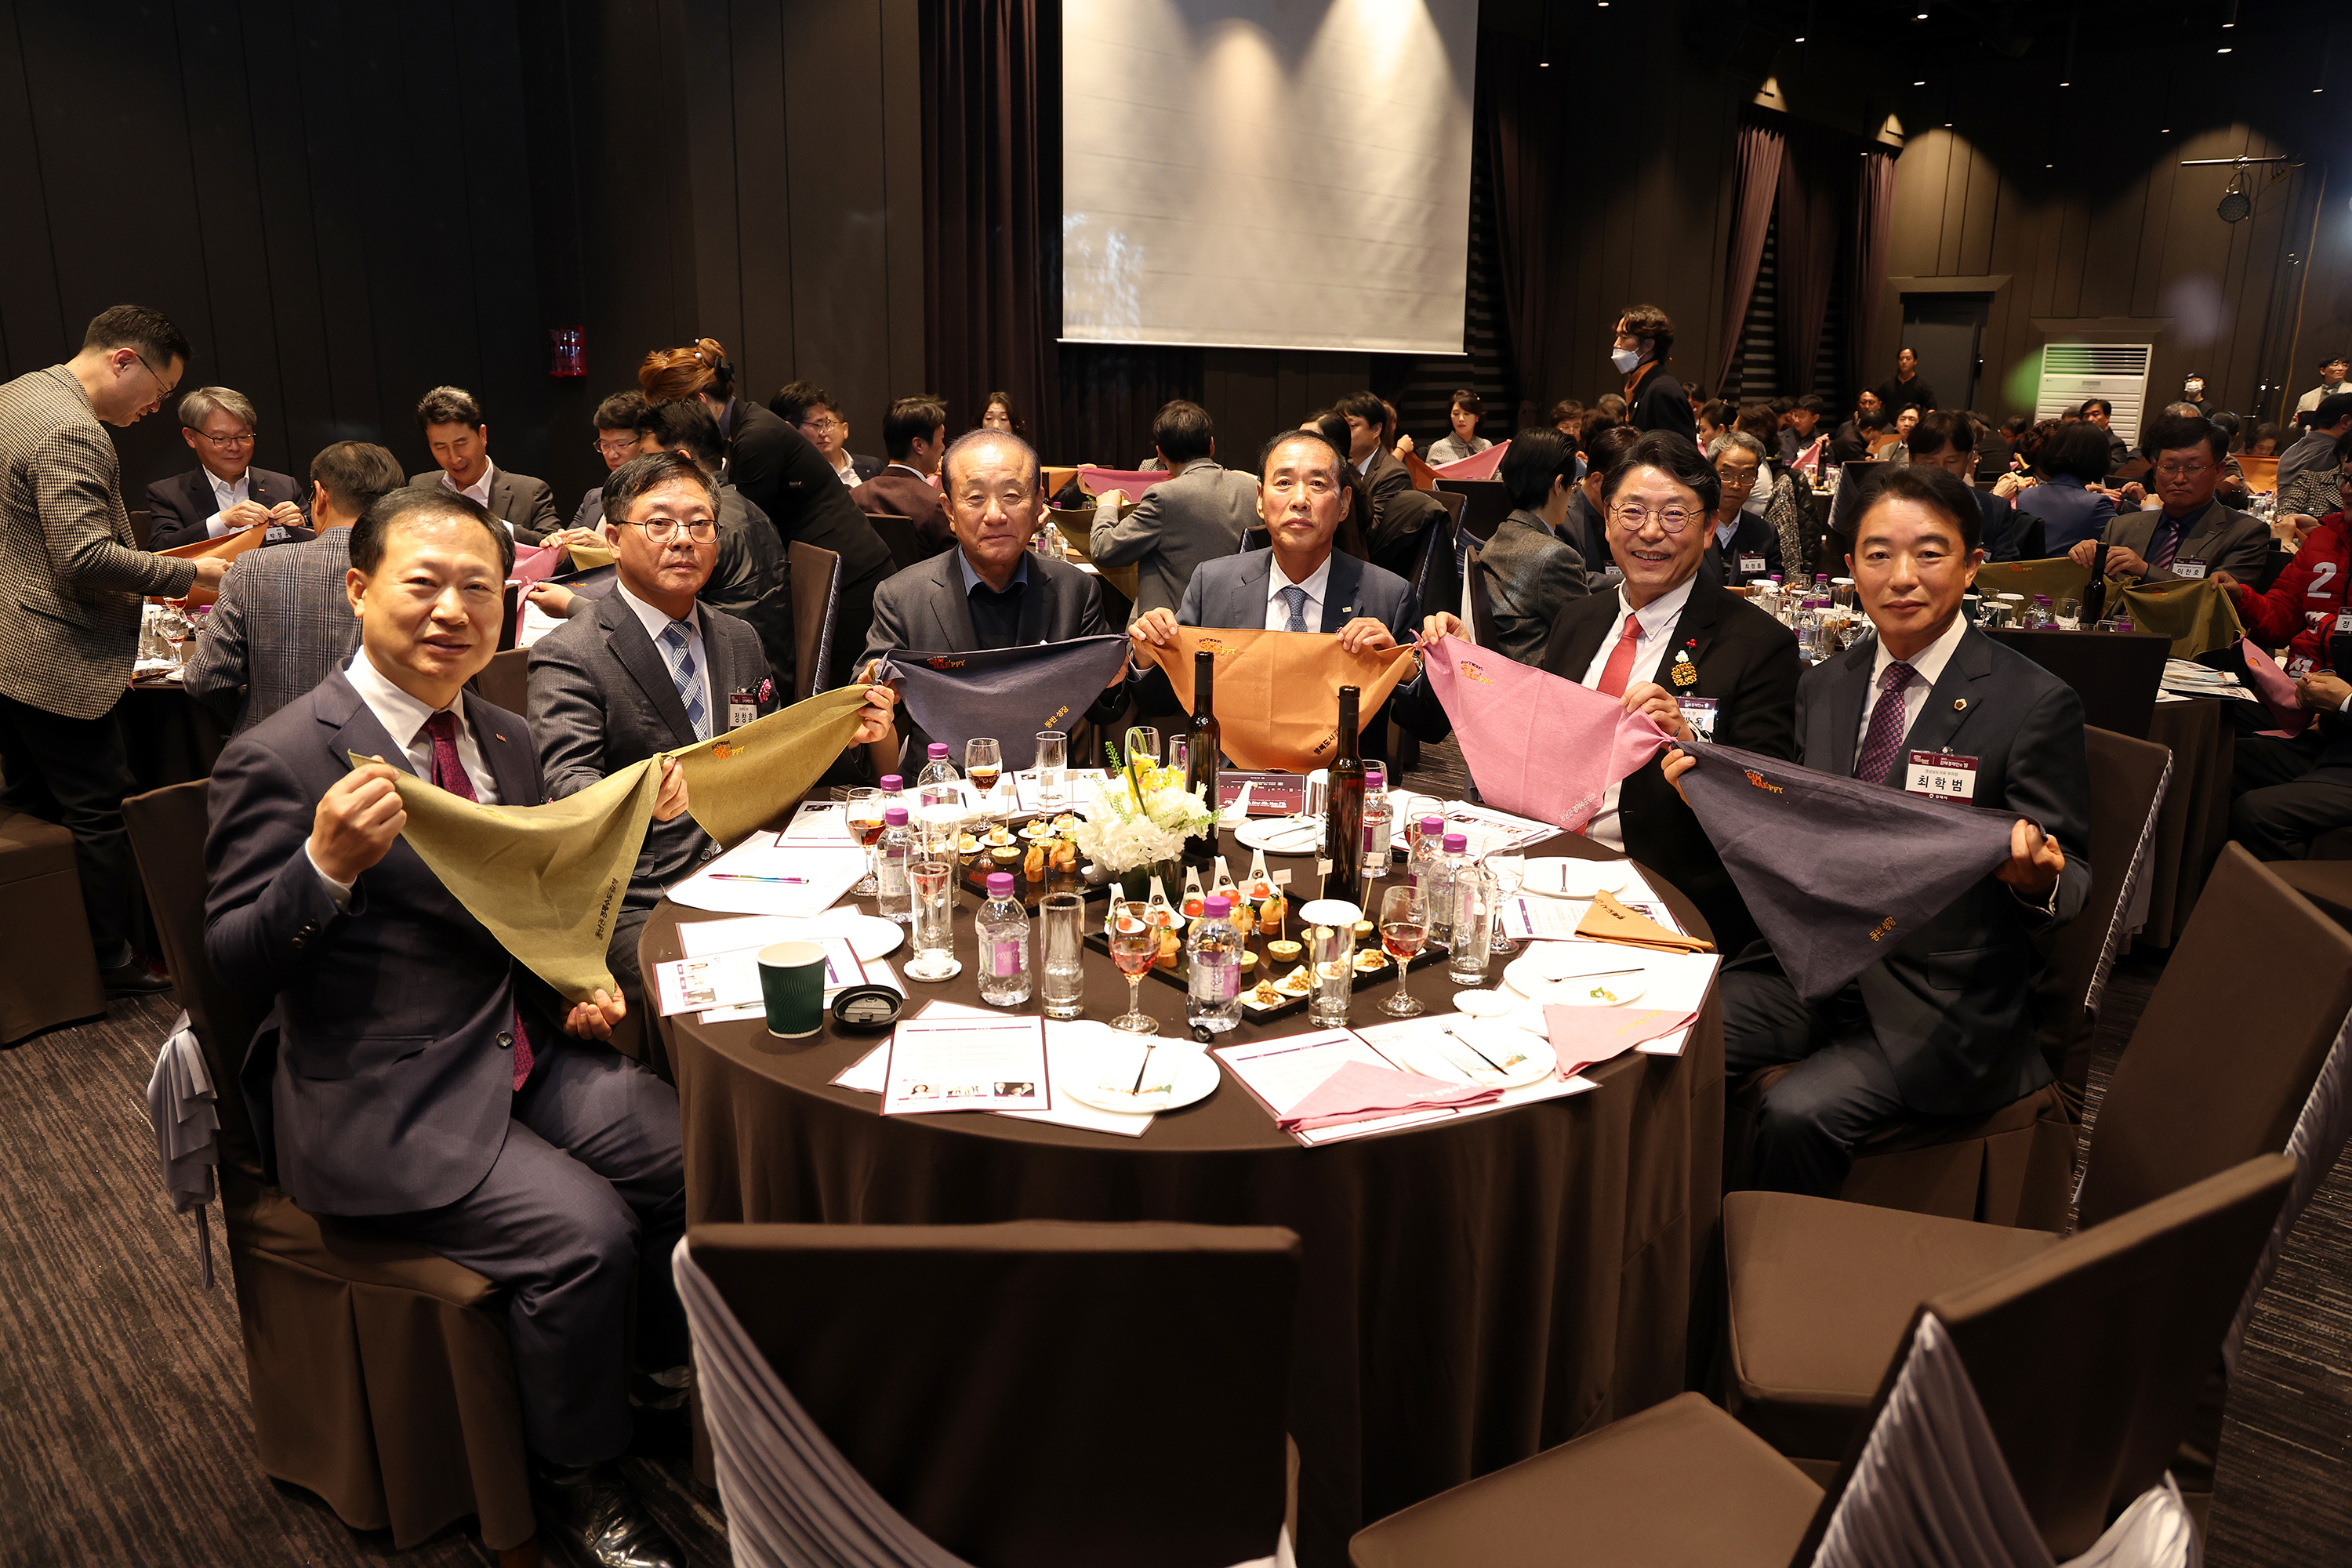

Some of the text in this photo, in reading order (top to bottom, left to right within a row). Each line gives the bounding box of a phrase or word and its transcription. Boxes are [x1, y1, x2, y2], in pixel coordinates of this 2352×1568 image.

[2307, 561, 2337, 599] 2
[1869, 916, 1896, 942] 동반 성장
